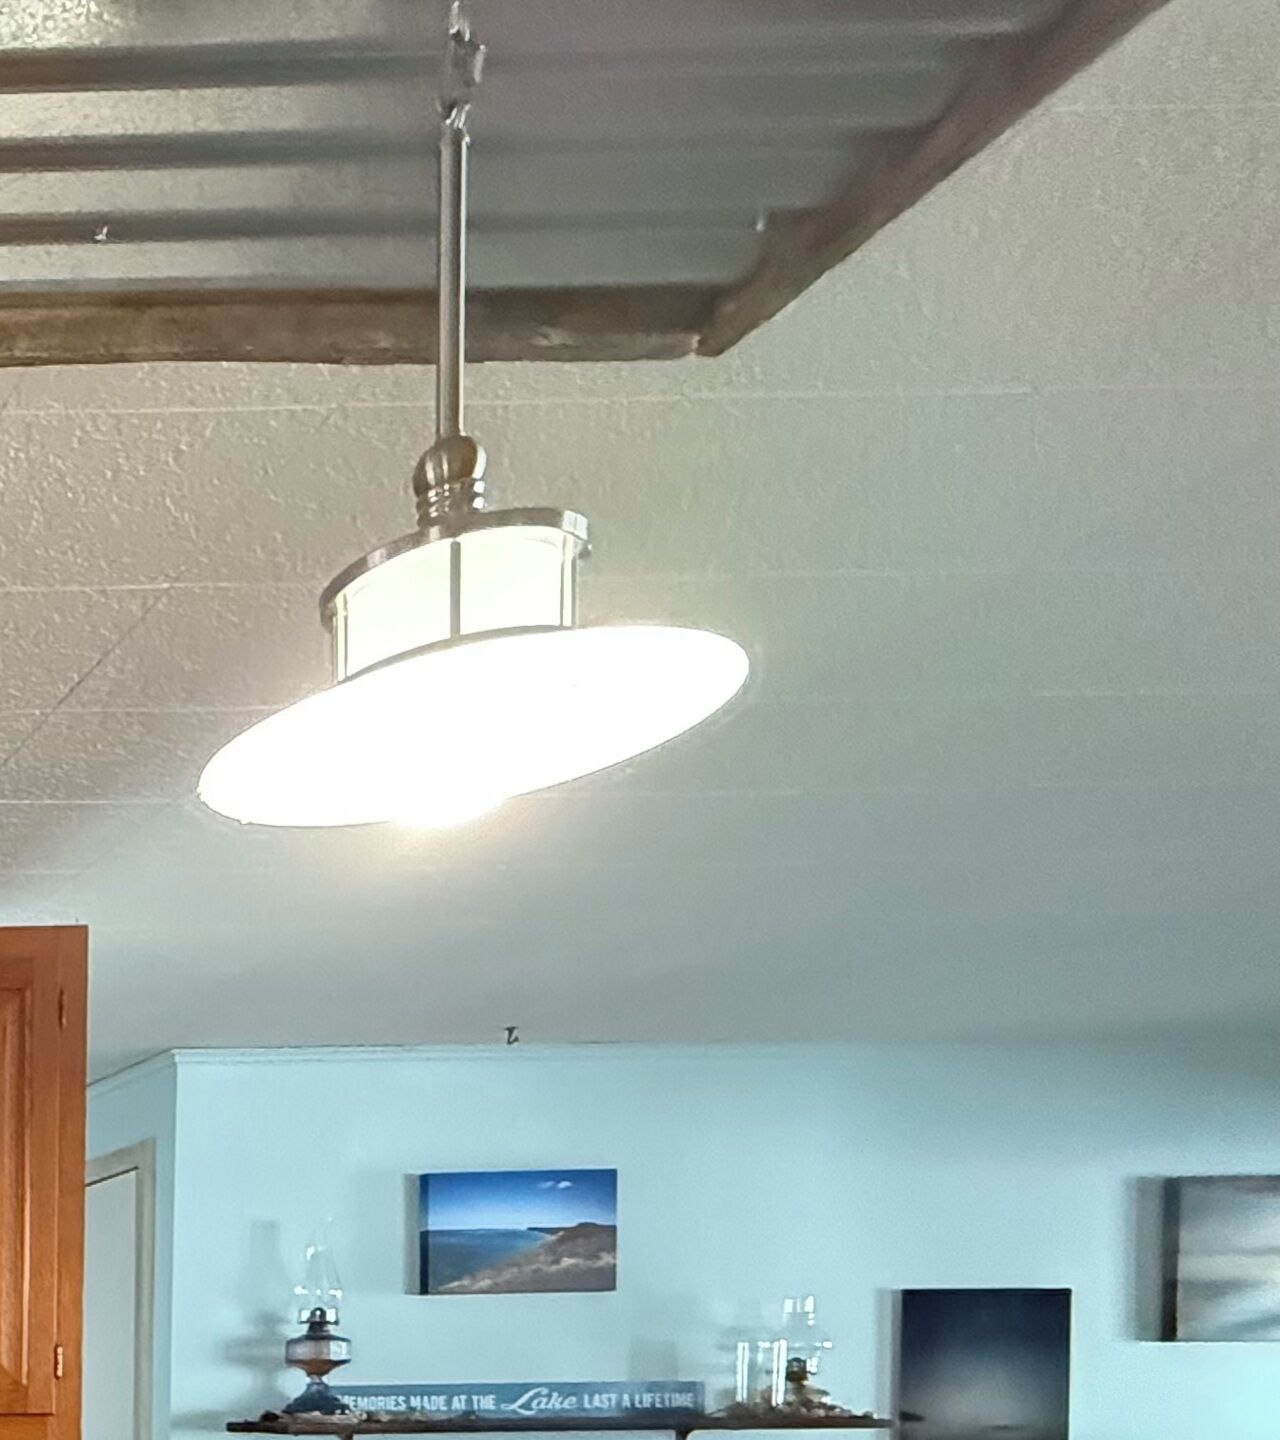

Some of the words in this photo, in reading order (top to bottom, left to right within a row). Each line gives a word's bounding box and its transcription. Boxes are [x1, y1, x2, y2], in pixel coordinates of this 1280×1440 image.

[340, 1395, 407, 1411] MEMORIES
[410, 1395, 447, 1410] MADE
[452, 1395, 467, 1410] AT
[472, 1394, 496, 1410] THE
[500, 1386, 576, 1415] Lake
[583, 1393, 617, 1408] LAST
[623, 1393, 631, 1408] A
[635, 1392, 694, 1408] LIFETIME
